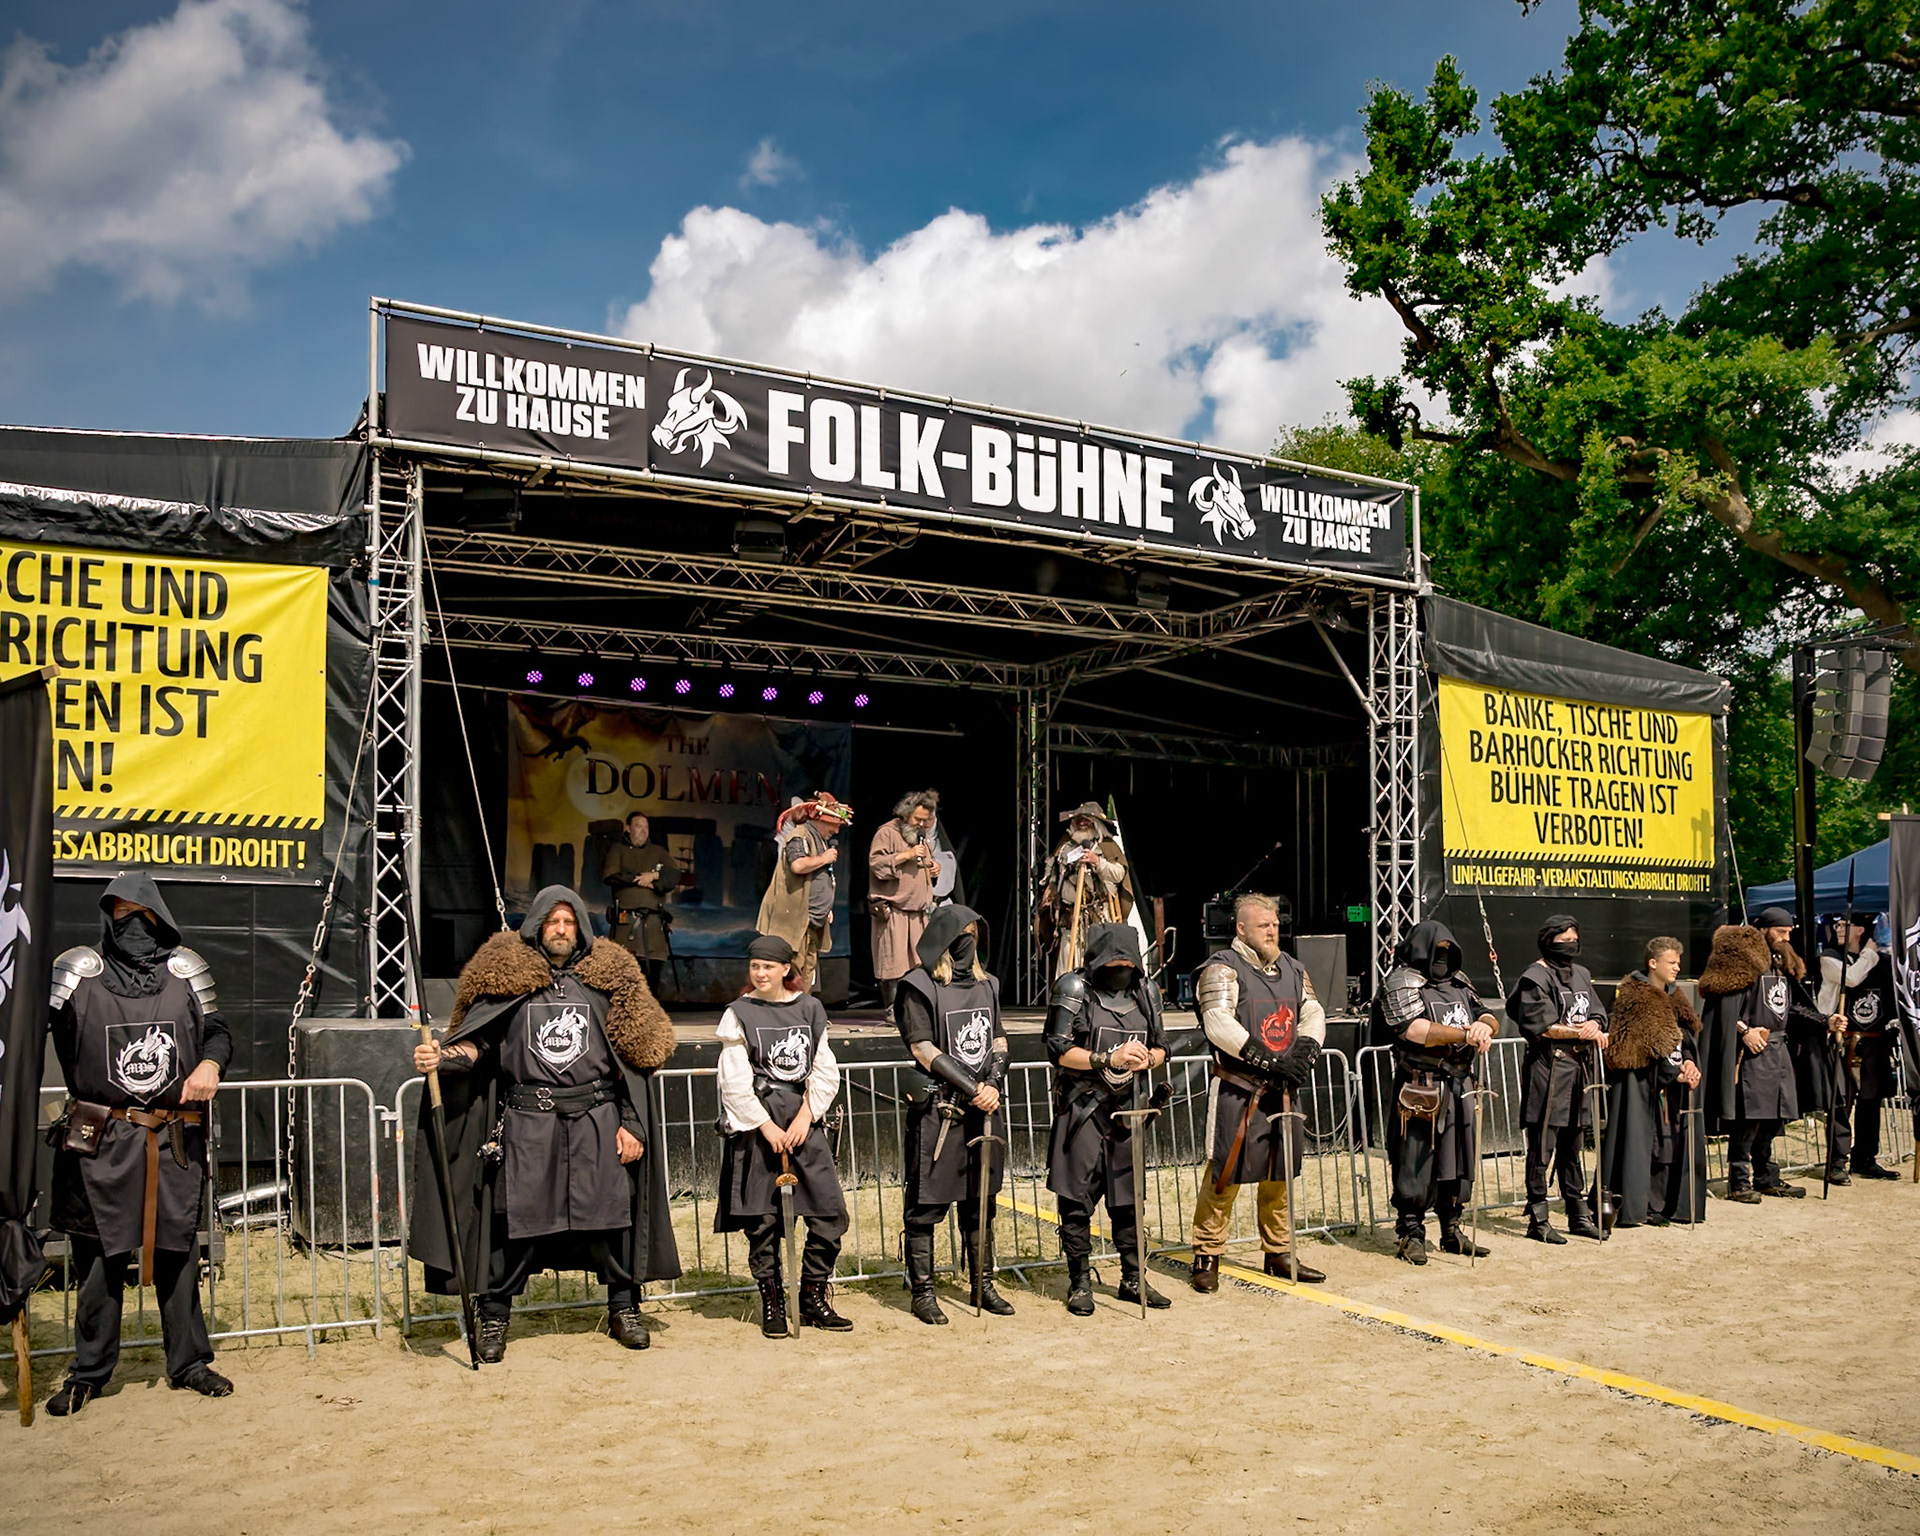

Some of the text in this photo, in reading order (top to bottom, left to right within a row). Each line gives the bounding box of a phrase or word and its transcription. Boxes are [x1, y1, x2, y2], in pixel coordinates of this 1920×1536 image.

[417, 342, 646, 410] WILLKOMMEN
[455, 385, 610, 441] ZU HAUSE
[766, 388, 1175, 534] FOLK-BÜHNE
[1259, 483, 1391, 530] WILLKOMMEN
[1282, 515, 1372, 554] ZU HAUSE
[0, 548, 229, 621] CHE UND
[0, 610, 263, 683] RICHTUNG
[48, 677, 219, 739] EN IST
[1484, 690, 1678, 745] BÄNKE, TISCHE UND
[53, 740, 115, 794] N!
[664, 734, 710, 756] THE
[1469, 729, 1693, 782] BARHOCKER RICHTUNG
[585, 757, 784, 806] DOLMEN
[1490, 766, 1679, 816] BÜHNE TRAGEN IST
[209, 836, 306, 870] DROHT!
[1533, 811, 1643, 850] VERBOTEN!
[1452, 865, 1711, 893] UNFALLGEFAHR-VERANSTALTUNGSABBRUCH DROHT!
